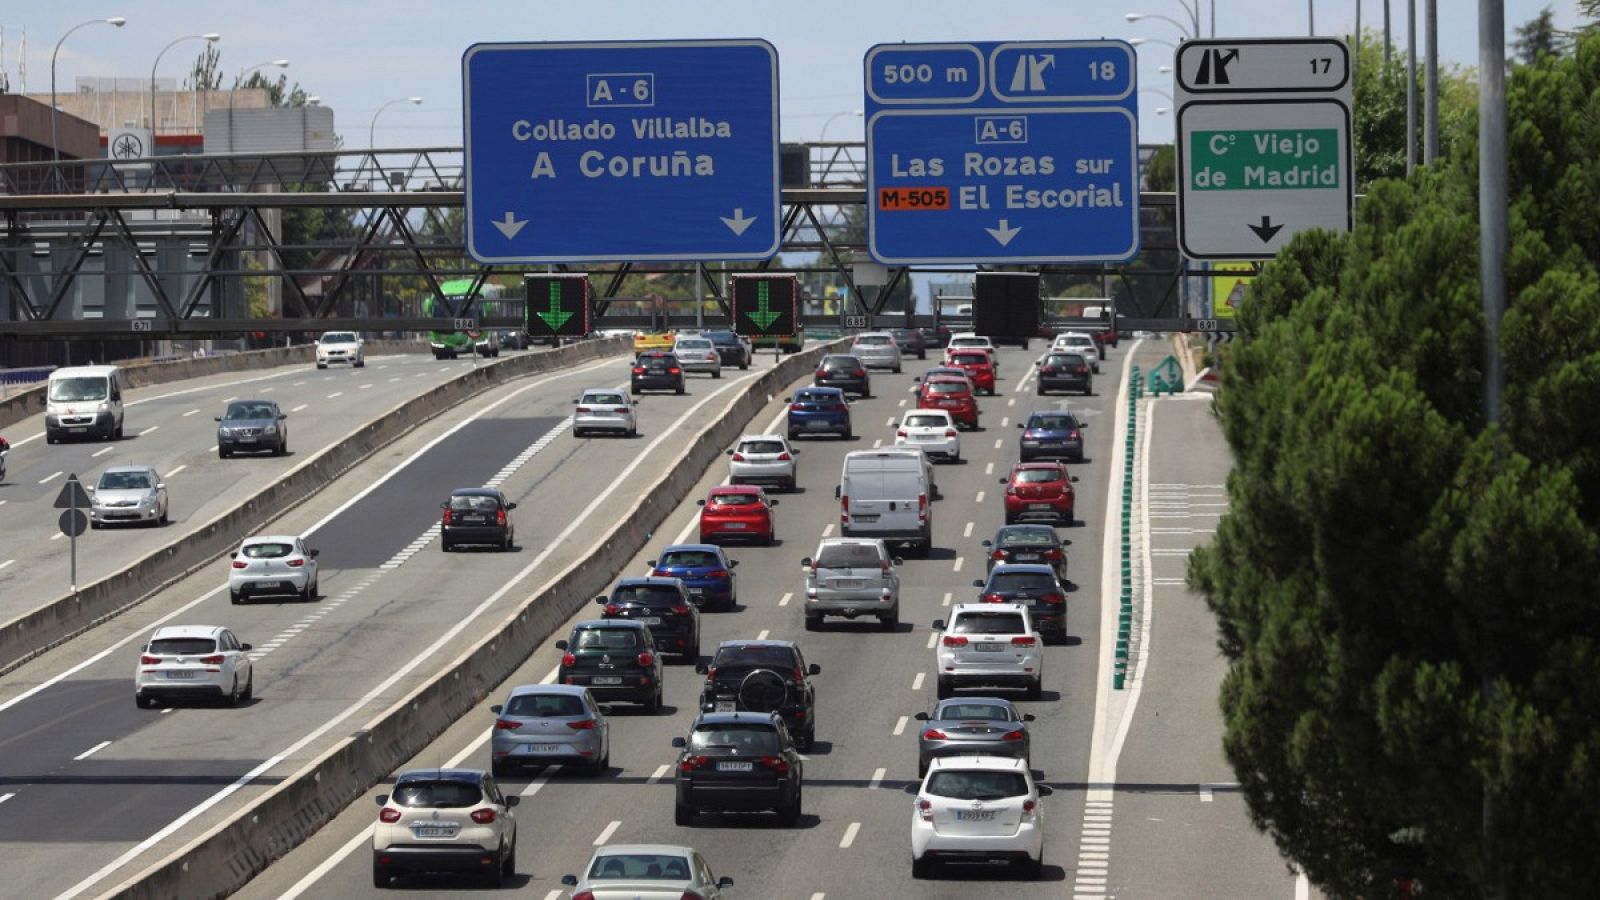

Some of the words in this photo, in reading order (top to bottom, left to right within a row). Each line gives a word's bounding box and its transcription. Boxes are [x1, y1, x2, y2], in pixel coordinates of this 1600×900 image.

[884, 64, 933, 83] 500
[946, 67, 968, 82] m
[1088, 61, 1116, 81] 18
[1309, 58, 1332, 75] 17
[511, 119, 616, 141] Collado
[631, 116, 732, 140] Villalba
[980, 120, 1024, 140] A-6
[1253, 132, 1320, 158] Viejo
[531, 151, 556, 179] A
[579, 150, 715, 178] Coruña
[891, 153, 945, 177] Las
[964, 152, 1055, 177] Rozas
[1075, 159, 1114, 175] sur
[1195, 167, 1227, 187] de
[1244, 164, 1336, 186] Madrid
[881, 190, 947, 207] M-505
[959, 185, 990, 209] El
[1006, 182, 1124, 209] Escorial
